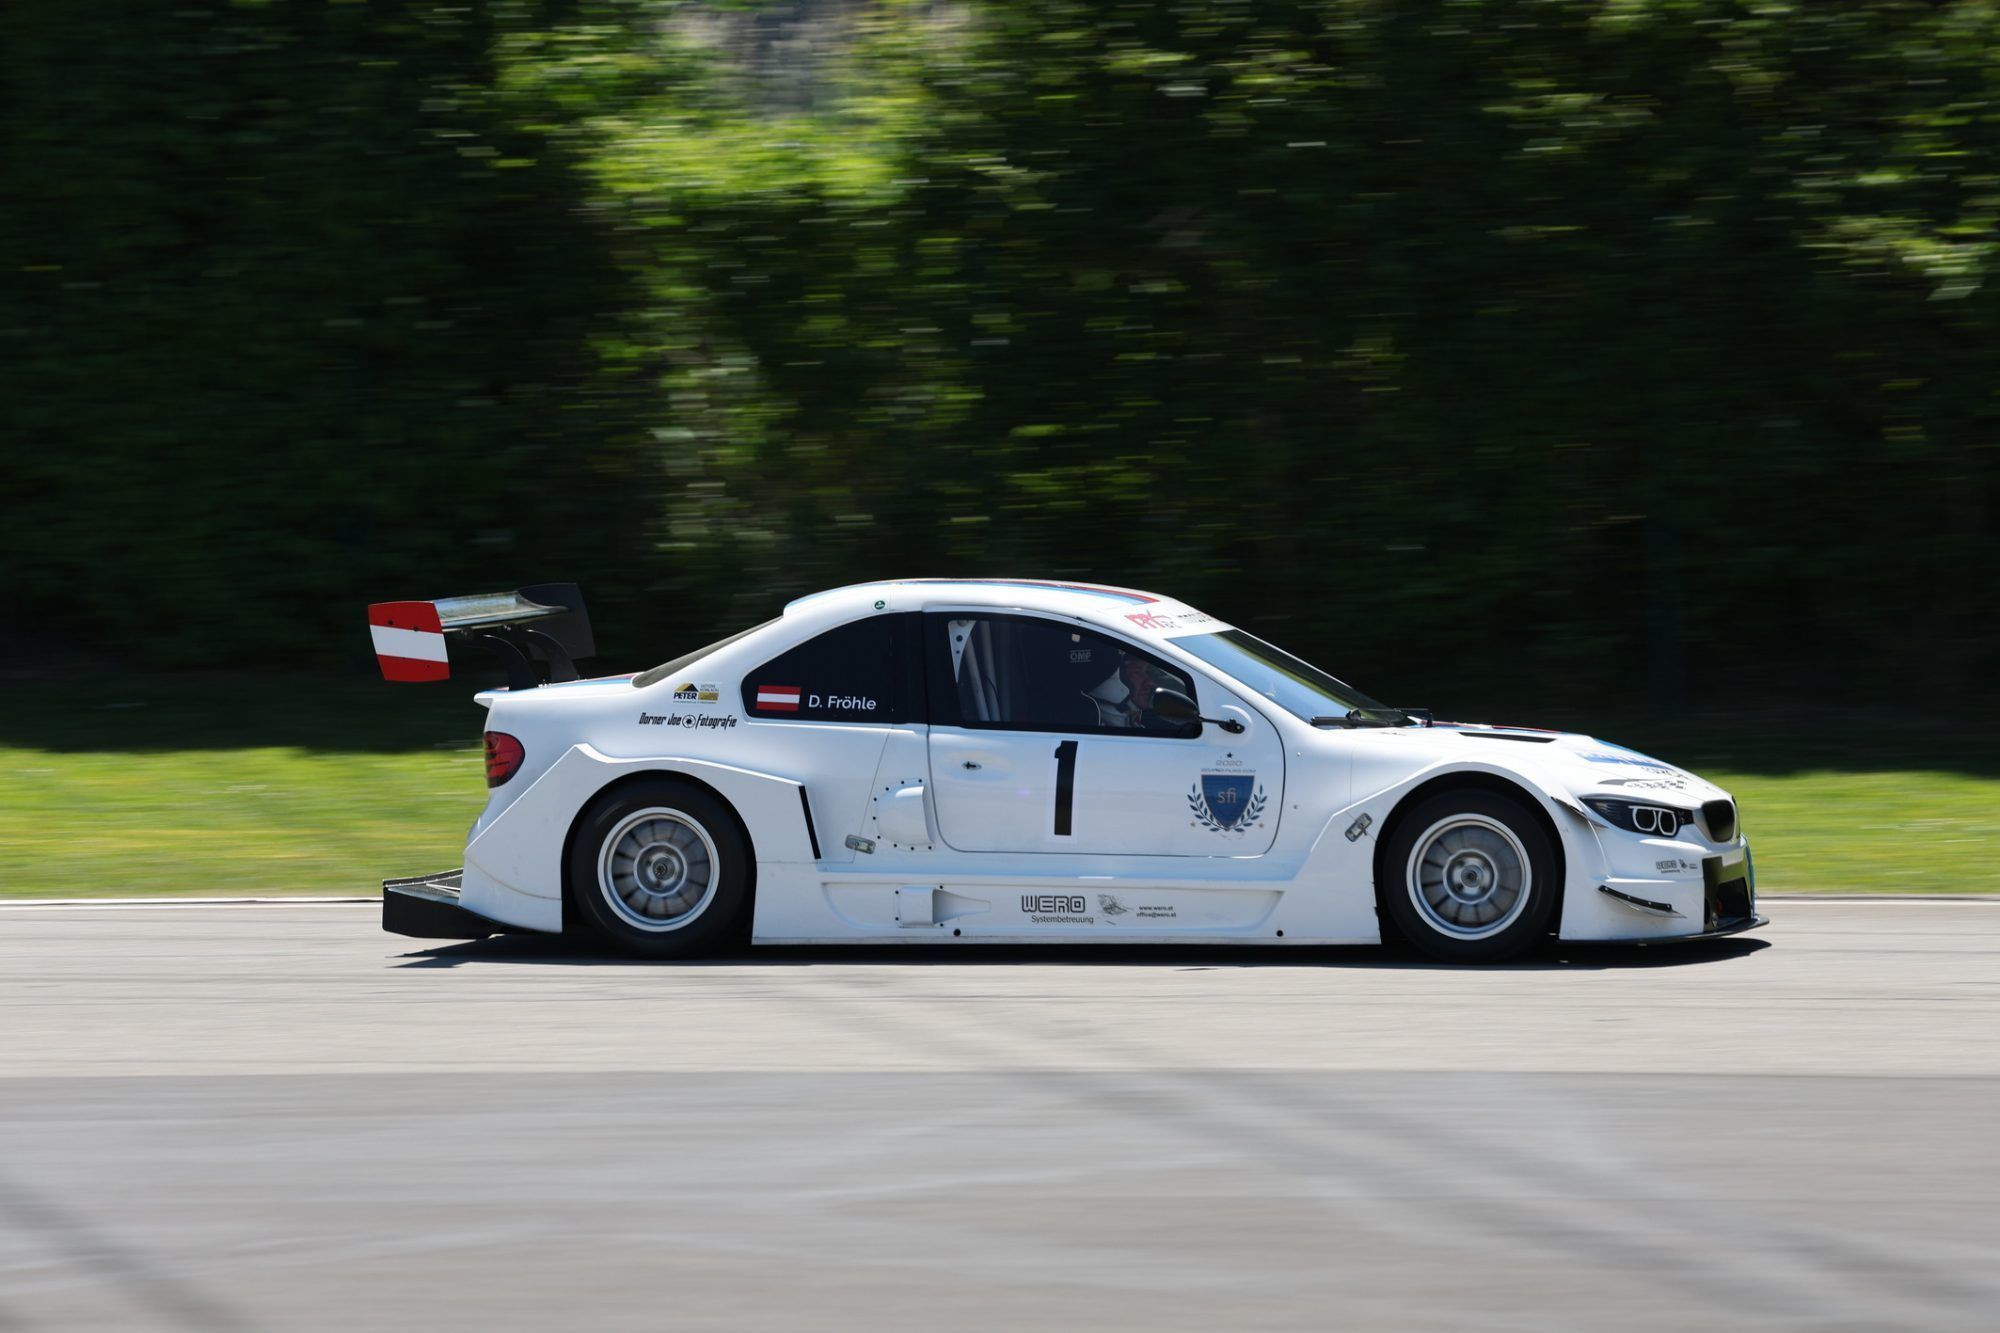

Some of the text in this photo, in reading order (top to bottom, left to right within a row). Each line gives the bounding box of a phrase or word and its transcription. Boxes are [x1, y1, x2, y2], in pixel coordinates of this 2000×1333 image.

[673, 691, 698, 700] PETER
[808, 694, 877, 710] D. Fröhle
[1054, 740, 1079, 836] 1
[1217, 786, 1237, 804] sfi
[1021, 895, 1086, 913] WERO
[1031, 914, 1095, 925] Systembetreuung
